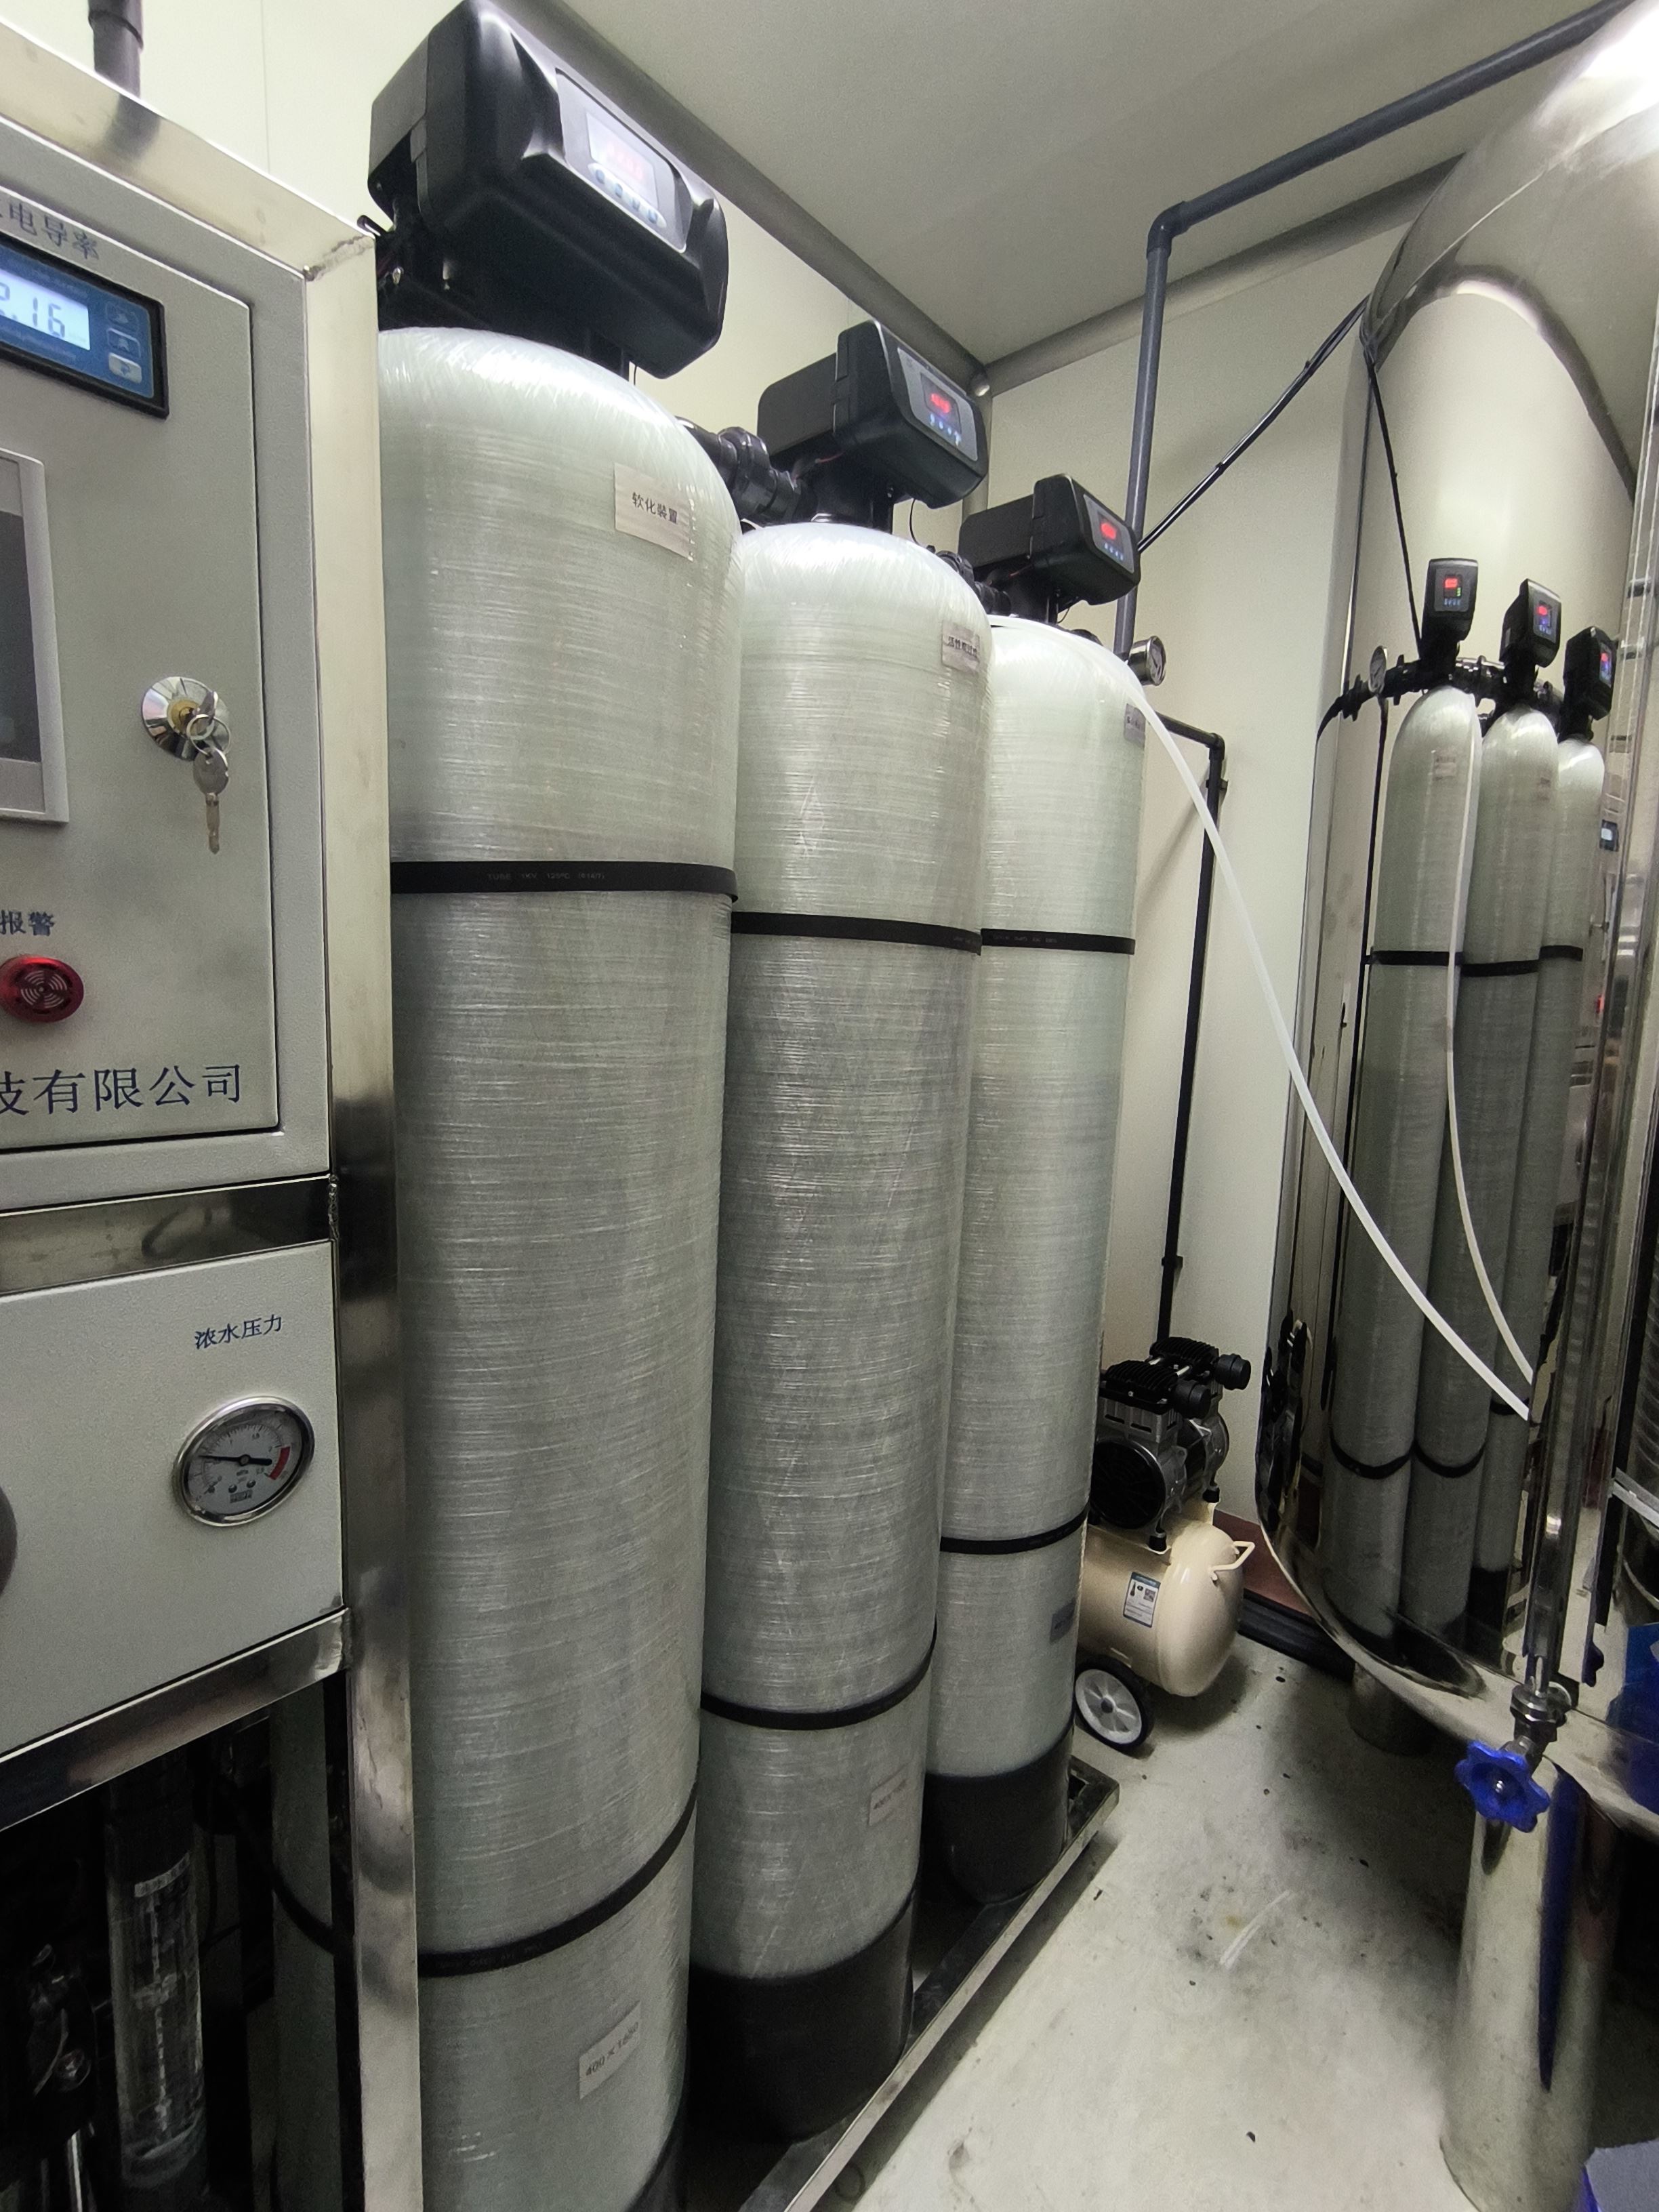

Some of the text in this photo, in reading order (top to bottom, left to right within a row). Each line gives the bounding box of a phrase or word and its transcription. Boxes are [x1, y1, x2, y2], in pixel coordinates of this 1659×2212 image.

[0, 199, 99, 260] 电导率
[0, 909, 55, 937] 报警
[194, 1314, 283, 1349] 浓水压力
